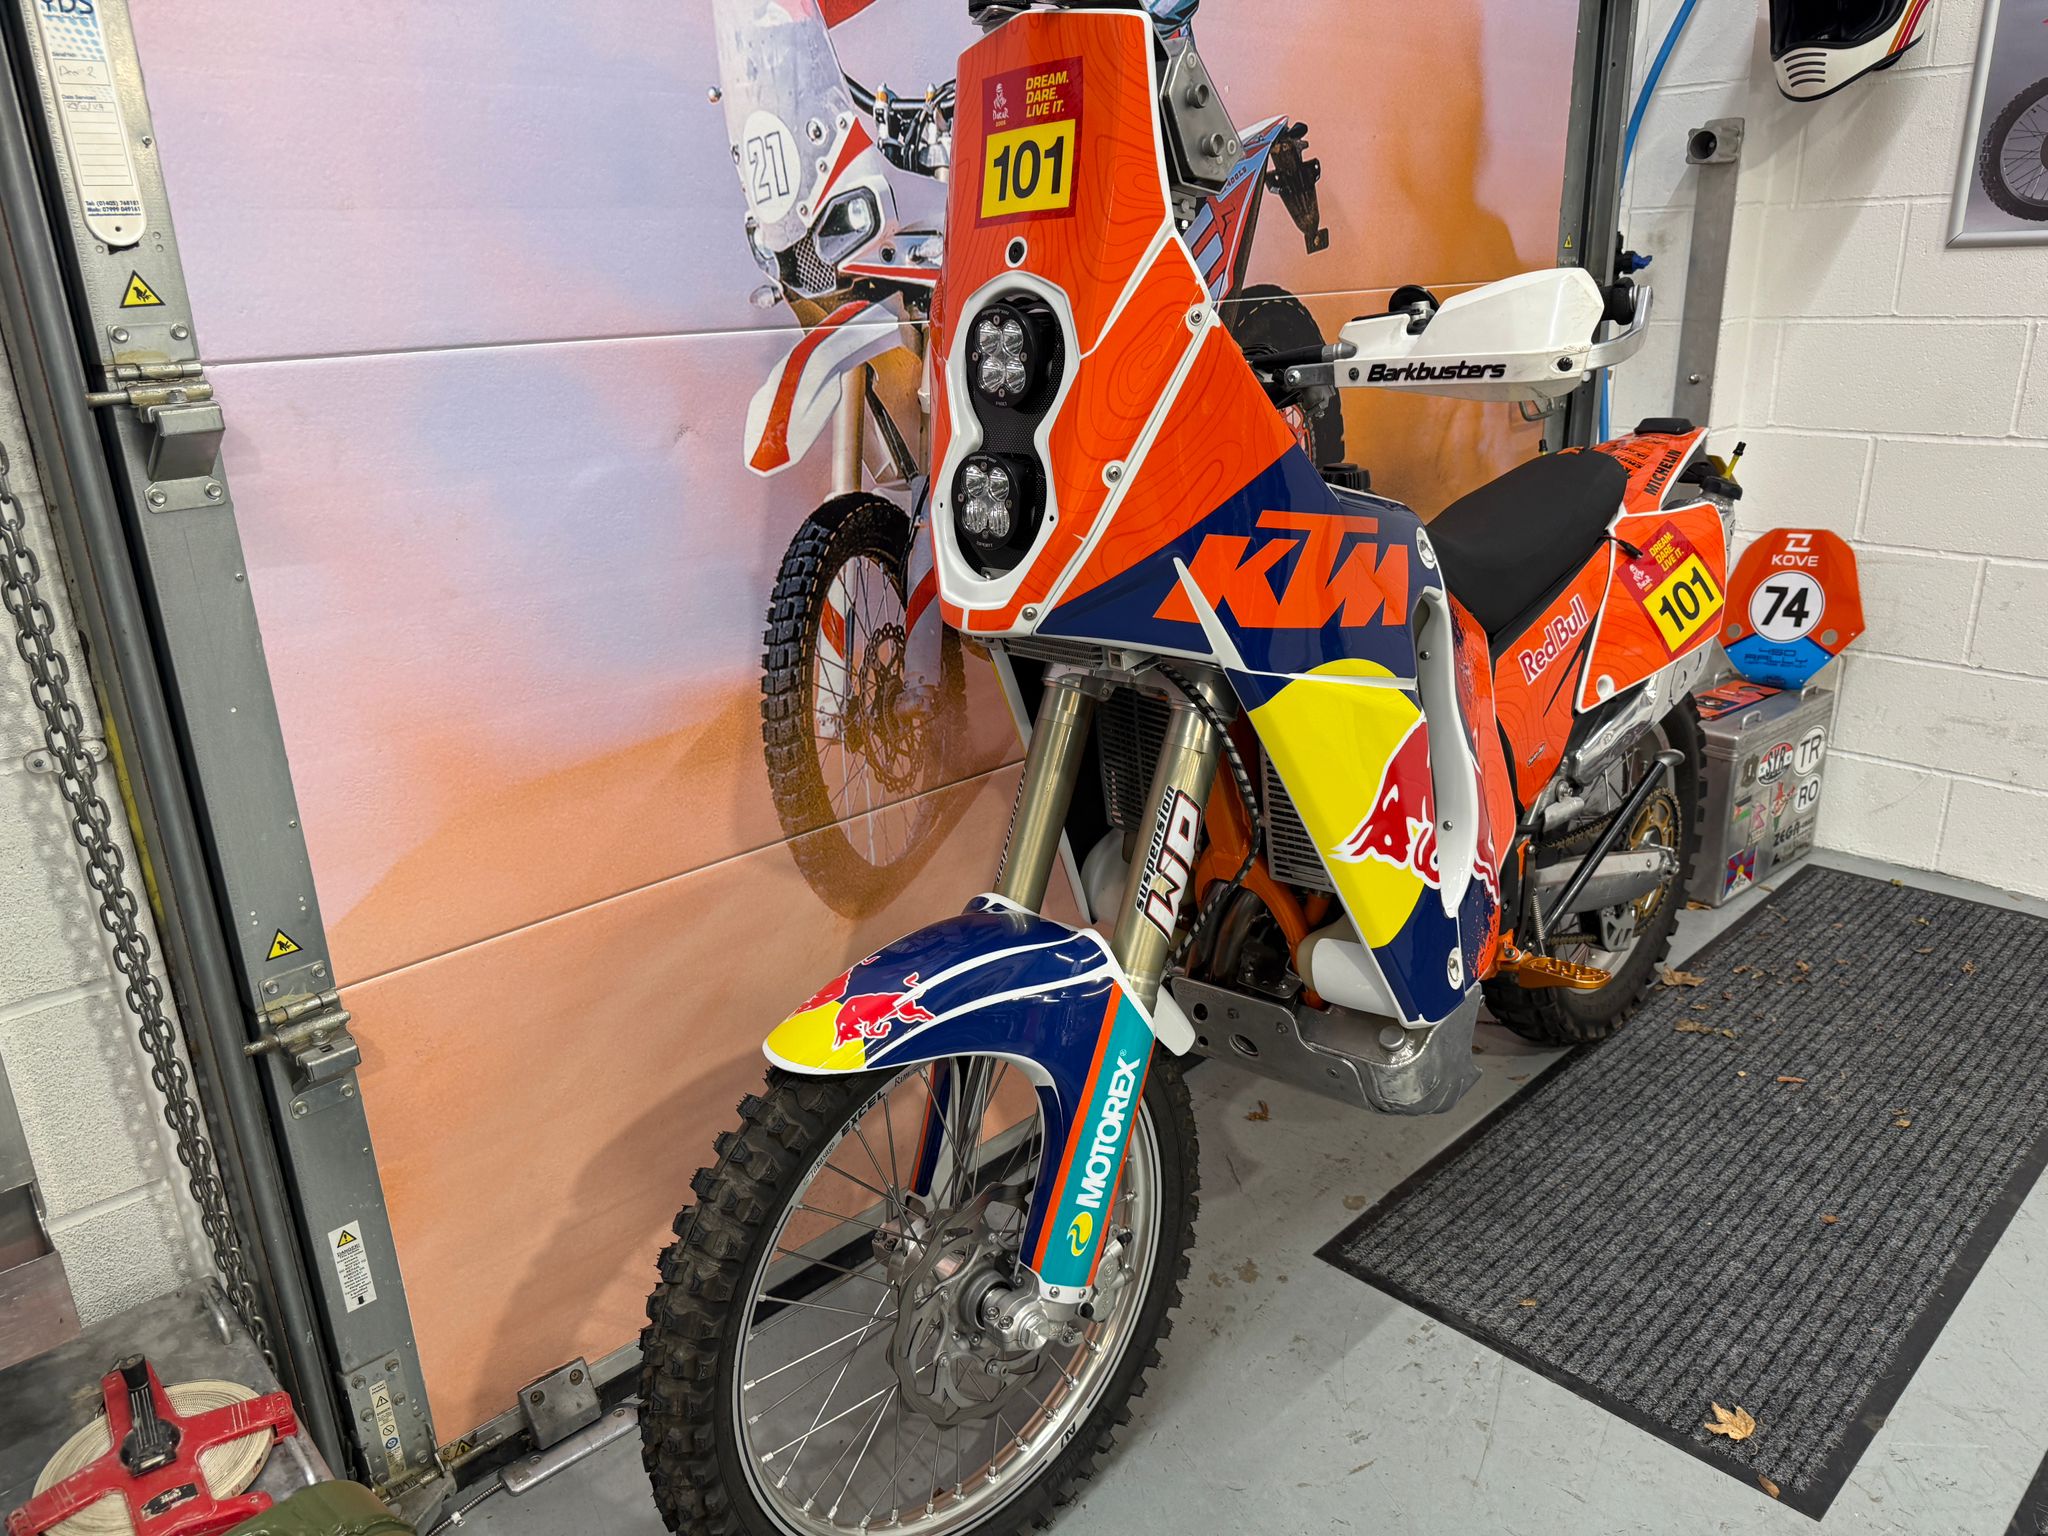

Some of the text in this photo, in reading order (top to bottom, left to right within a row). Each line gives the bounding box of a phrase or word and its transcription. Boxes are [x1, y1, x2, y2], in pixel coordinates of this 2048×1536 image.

[1025, 70, 1069, 91] DREAM.
[1026, 87, 1059, 104] DARE.
[1026, 100, 1065, 118] LIVE IT.
[747, 130, 790, 205] 21
[993, 135, 1065, 202] 101
[1367, 360, 1507, 382] Barkbusters
[1643, 449, 1683, 496] MICHELIN
[1648, 531, 1675, 557] DREAM.
[1654, 543, 1676, 565] DARE.
[1660, 547, 1685, 573] LIVE IT.
[1771, 554, 1820, 567] KOVE
[1152, 510, 1409, 629] KTM
[1658, 566, 1715, 633] 101
[1760, 585, 1810, 628] 74
[1518, 593, 1589, 686] Red Bull
[1765, 745, 1786, 778] SYR
[1800, 734, 1822, 768] TR
[1798, 779, 1819, 809] RO
[1136, 785, 1175, 913] suspension
[1772, 821, 1801, 849] ZEGA
[1143, 789, 1202, 944] WP
[841, 1091, 886, 1138] EXCEL
[1075, 1055, 1141, 1209] MOTOREX
